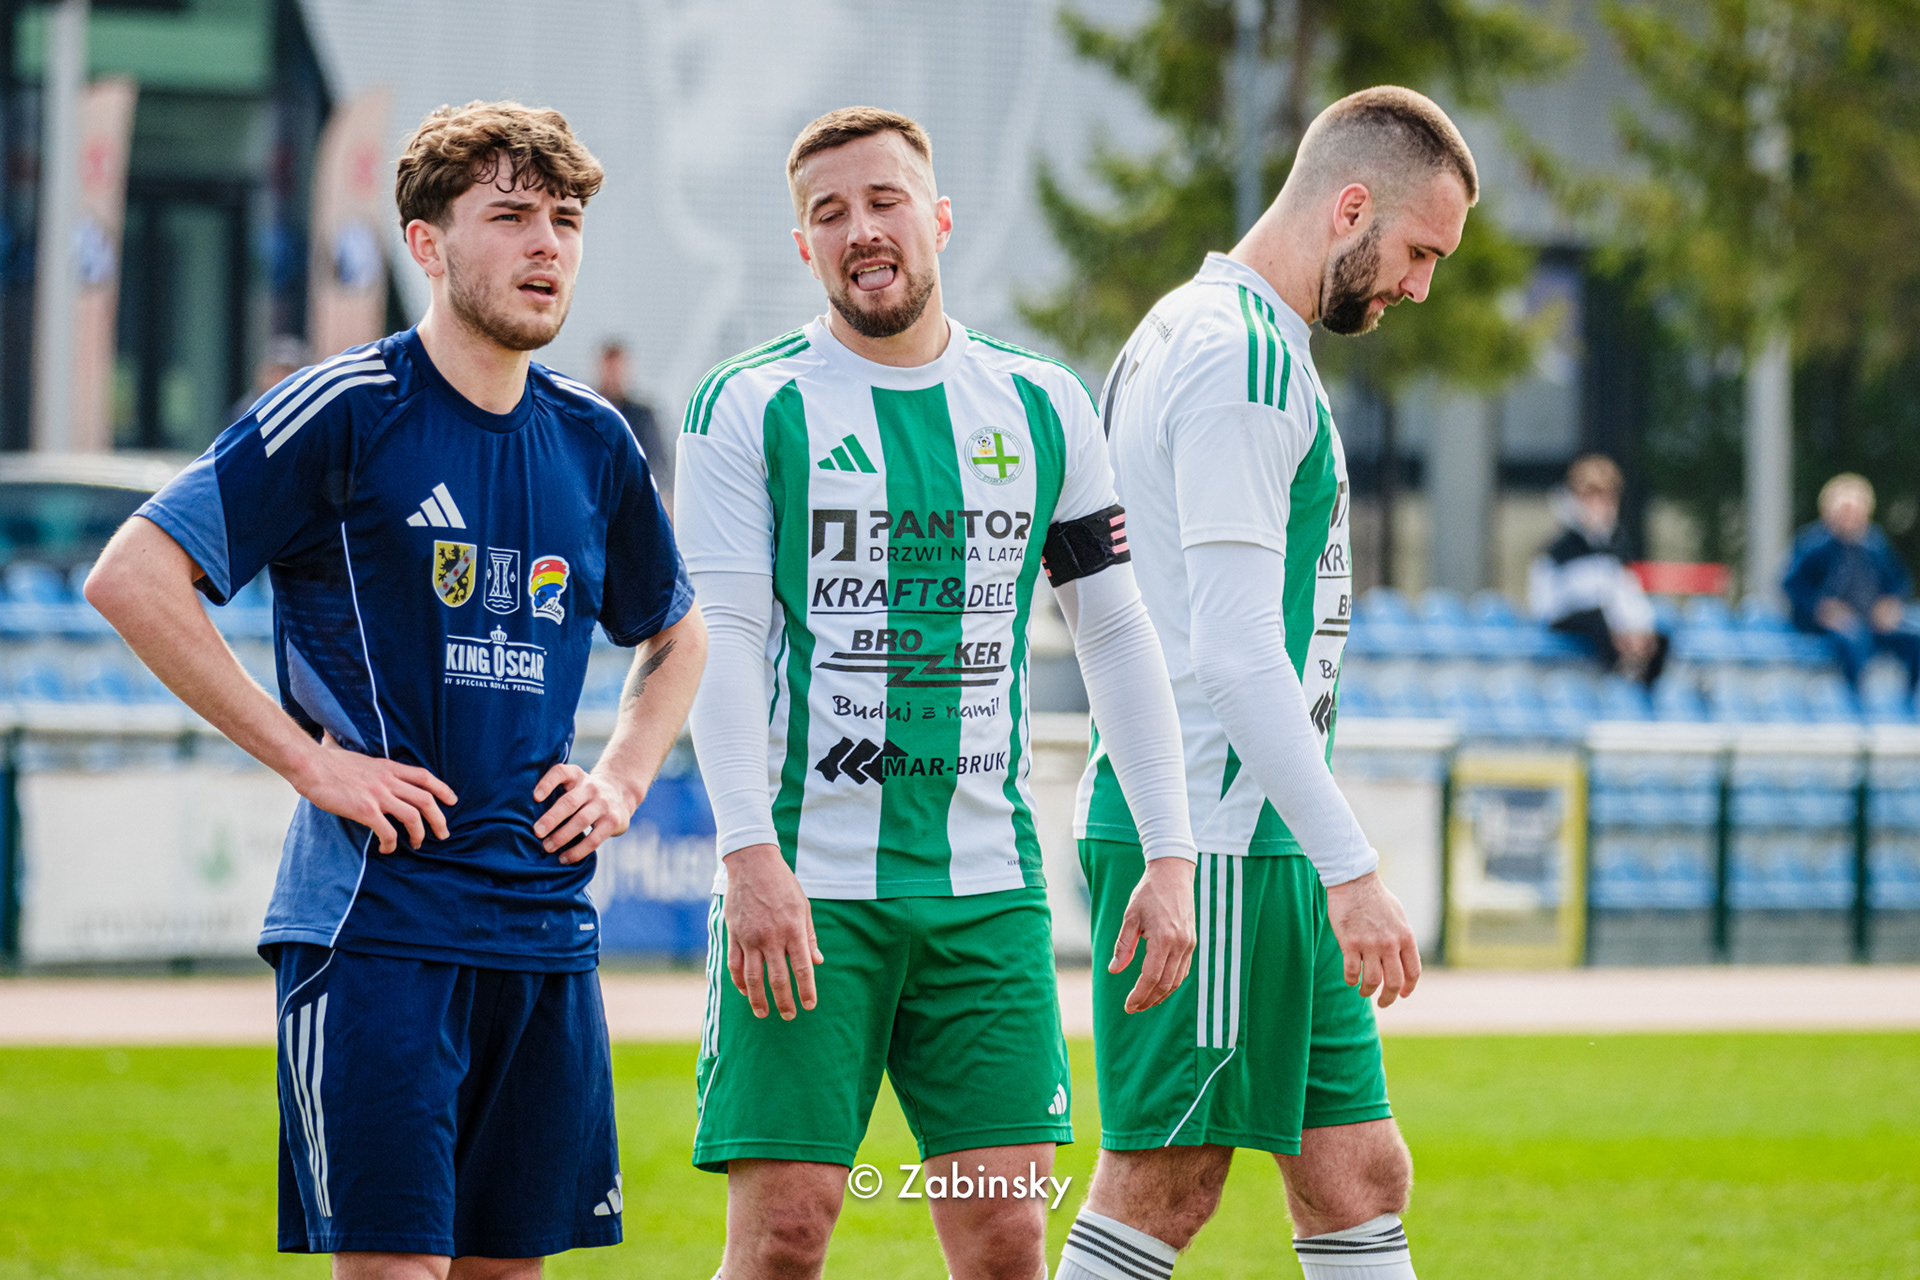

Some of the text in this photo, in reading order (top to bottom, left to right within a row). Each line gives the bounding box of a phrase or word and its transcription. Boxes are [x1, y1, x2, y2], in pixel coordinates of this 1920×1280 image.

[869, 510, 1031, 540] PANTOR
[869, 546, 1024, 562] DRZWI NA LATA
[445, 643, 544, 681] KING OSCAR
[455, 678, 488, 688] SPECIAL
[490, 681, 510, 690] ROYAL
[512, 684, 545, 695] PERMISSION
[832, 695, 999, 722] Buduj z nami!
[883, 751, 1006, 777] MAR-BRUK
